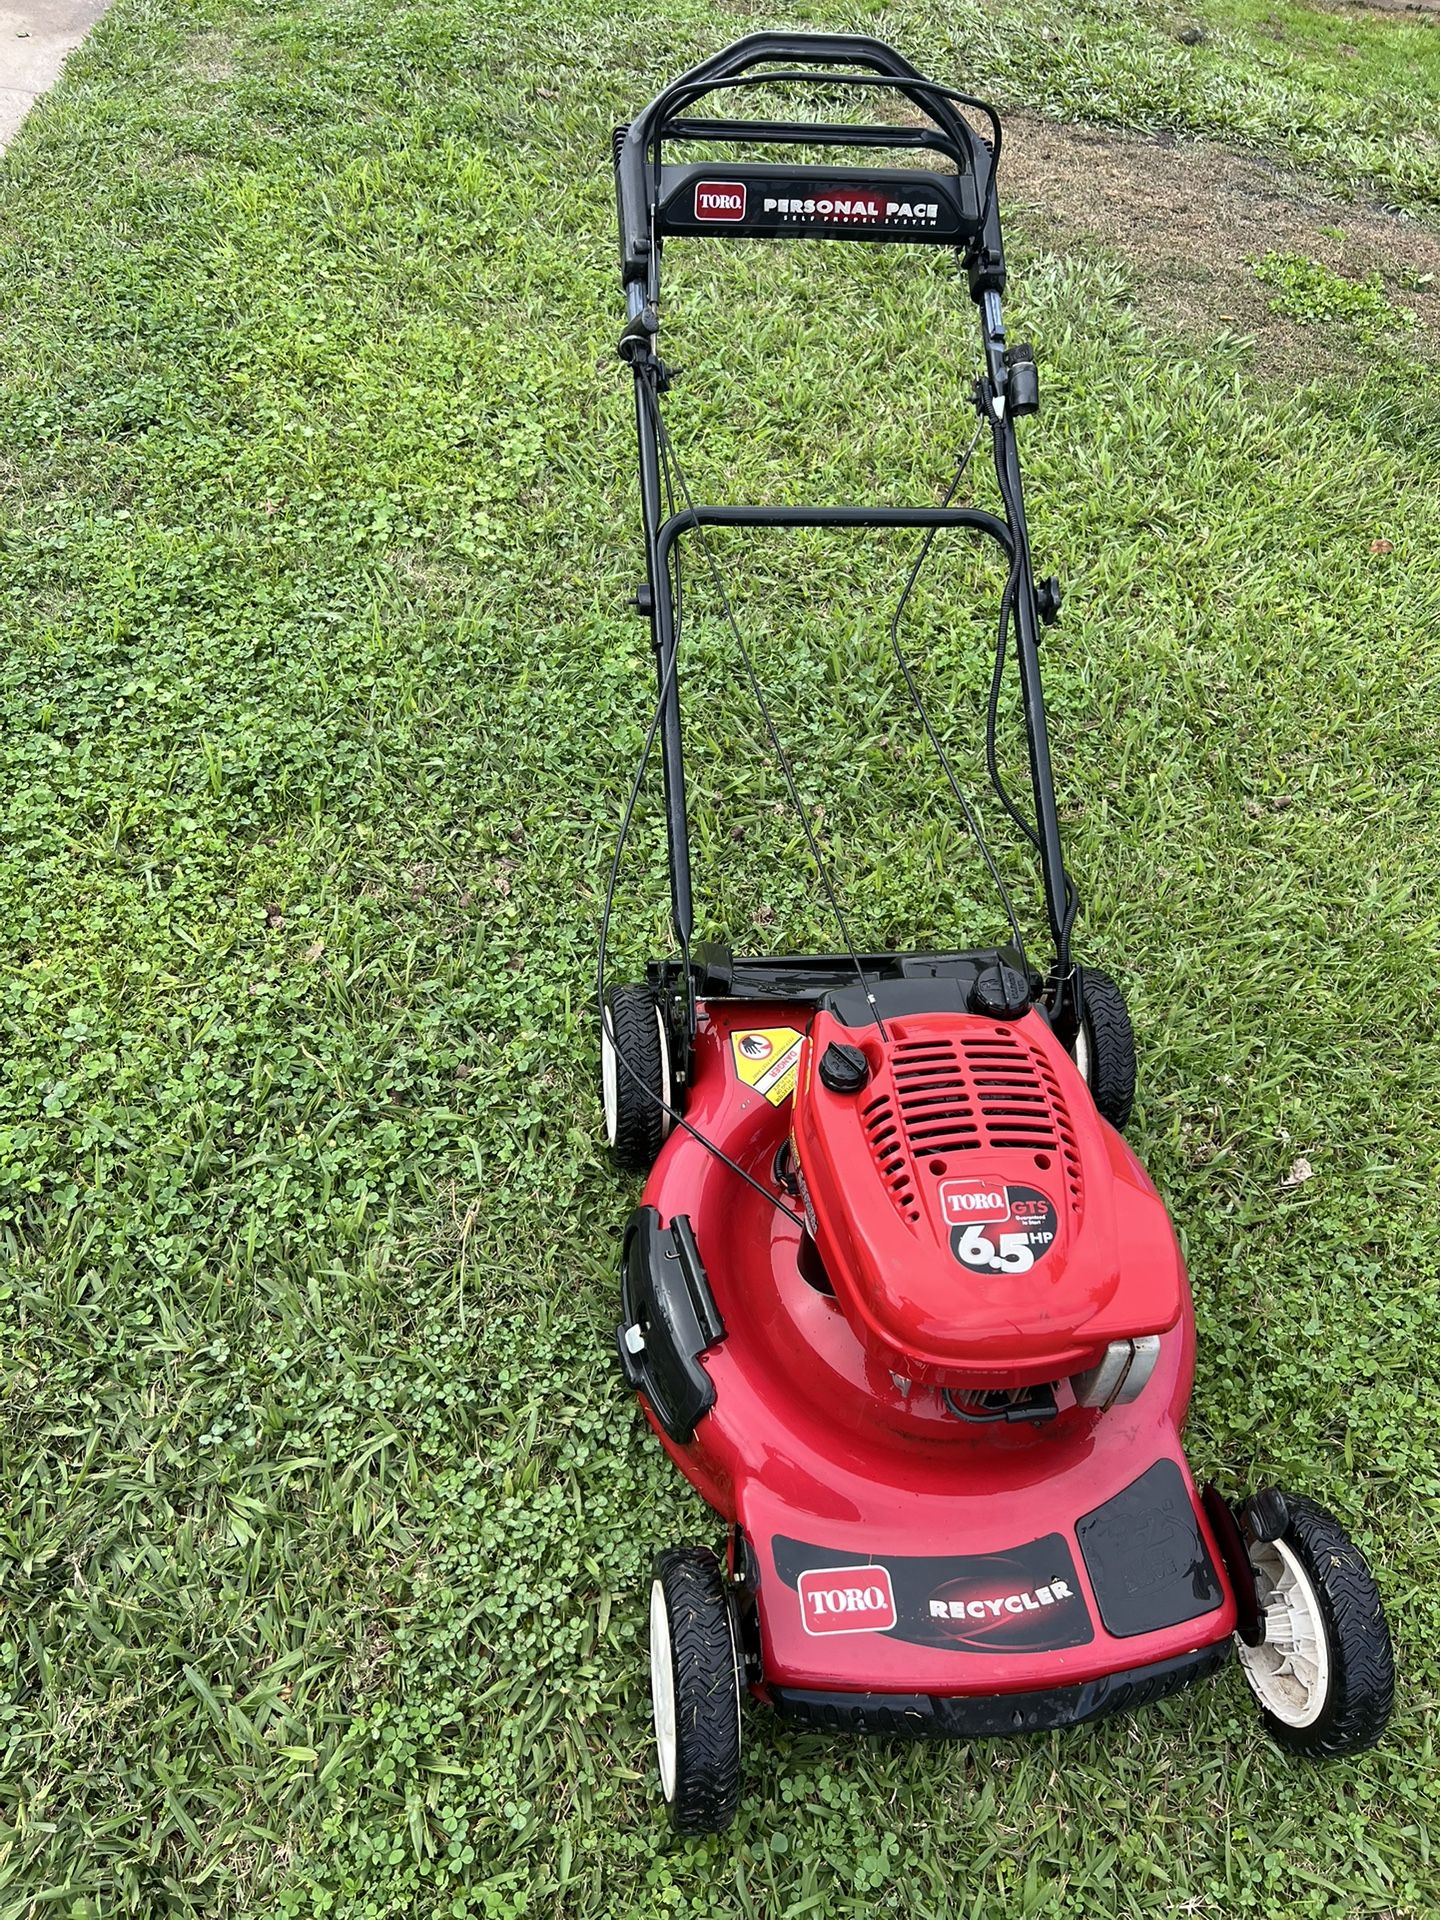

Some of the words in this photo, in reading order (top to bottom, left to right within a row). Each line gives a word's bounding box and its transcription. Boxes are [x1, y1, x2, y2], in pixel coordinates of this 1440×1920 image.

[700, 194, 742, 210] TORO
[764, 199, 879, 216] PERSONAL
[886, 202, 938, 218] PACE
[783, 214, 816, 222] SELF
[823, 216, 876, 224] PROPEL
[884, 218, 937, 226] SYSTEM
[769, 1050, 797, 1078] DANGER
[948, 1193, 1004, 1211] TORO
[1011, 1201, 1048, 1214] GTS
[958, 1225, 1034, 1273] 6.5
[1030, 1232, 1053, 1244] HP
[808, 1587, 888, 1615] TORO
[929, 1580, 1074, 1619] RECYCLER
